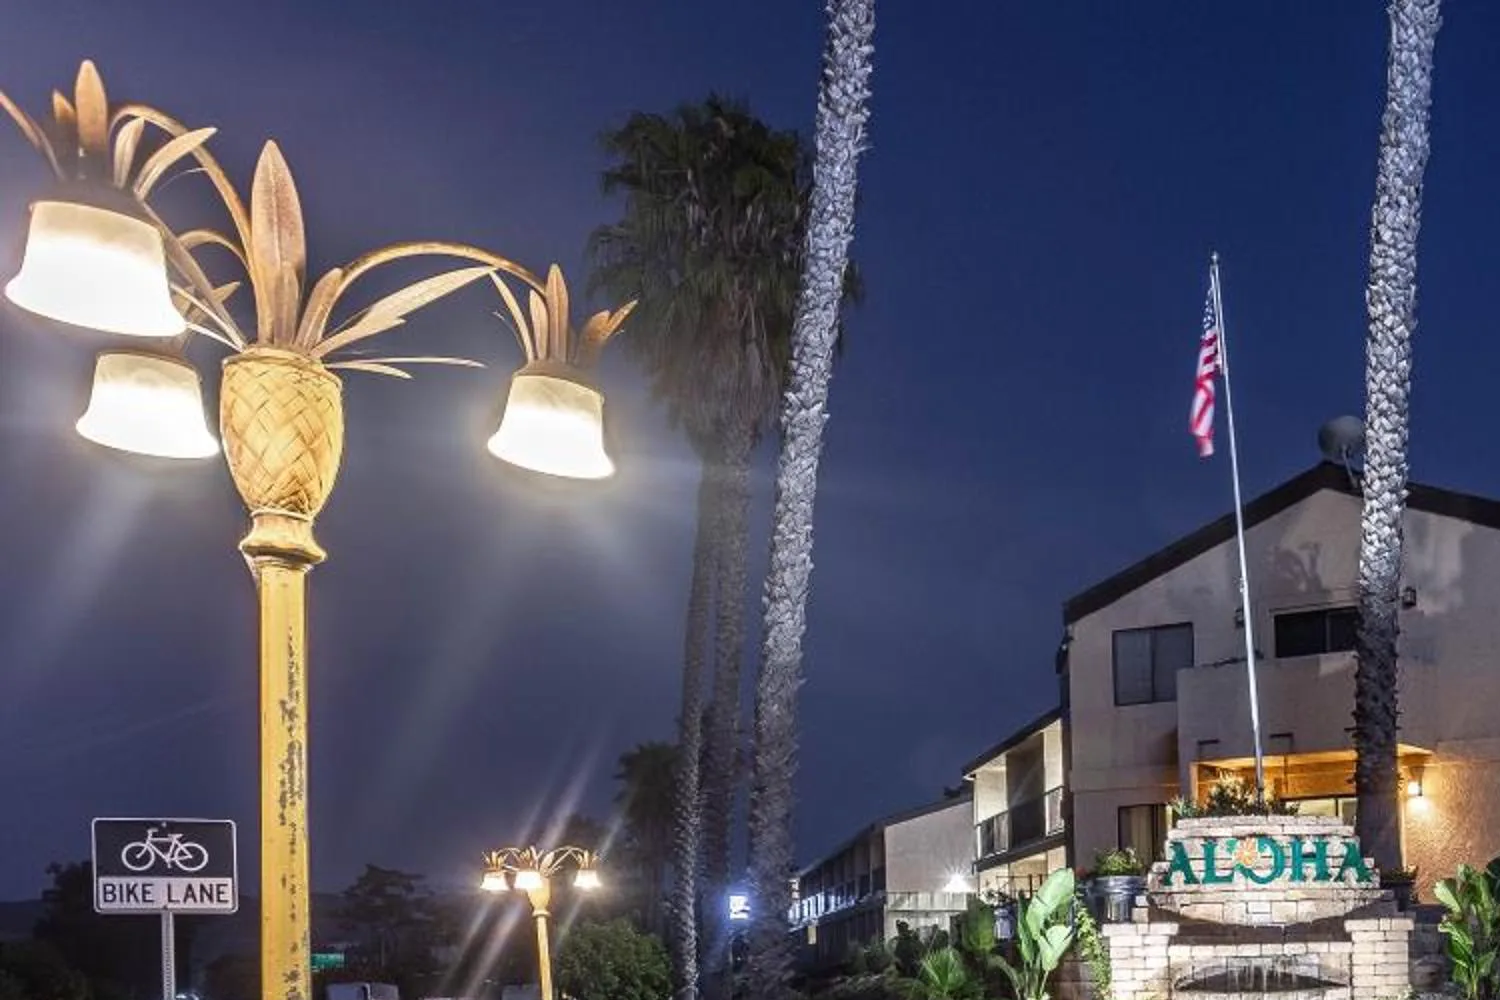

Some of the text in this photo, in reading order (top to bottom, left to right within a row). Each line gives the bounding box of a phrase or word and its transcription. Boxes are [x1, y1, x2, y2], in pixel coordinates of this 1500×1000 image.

[1162, 836, 1374, 885] ALOHA
[102, 883, 230, 904] BIKE LANE
